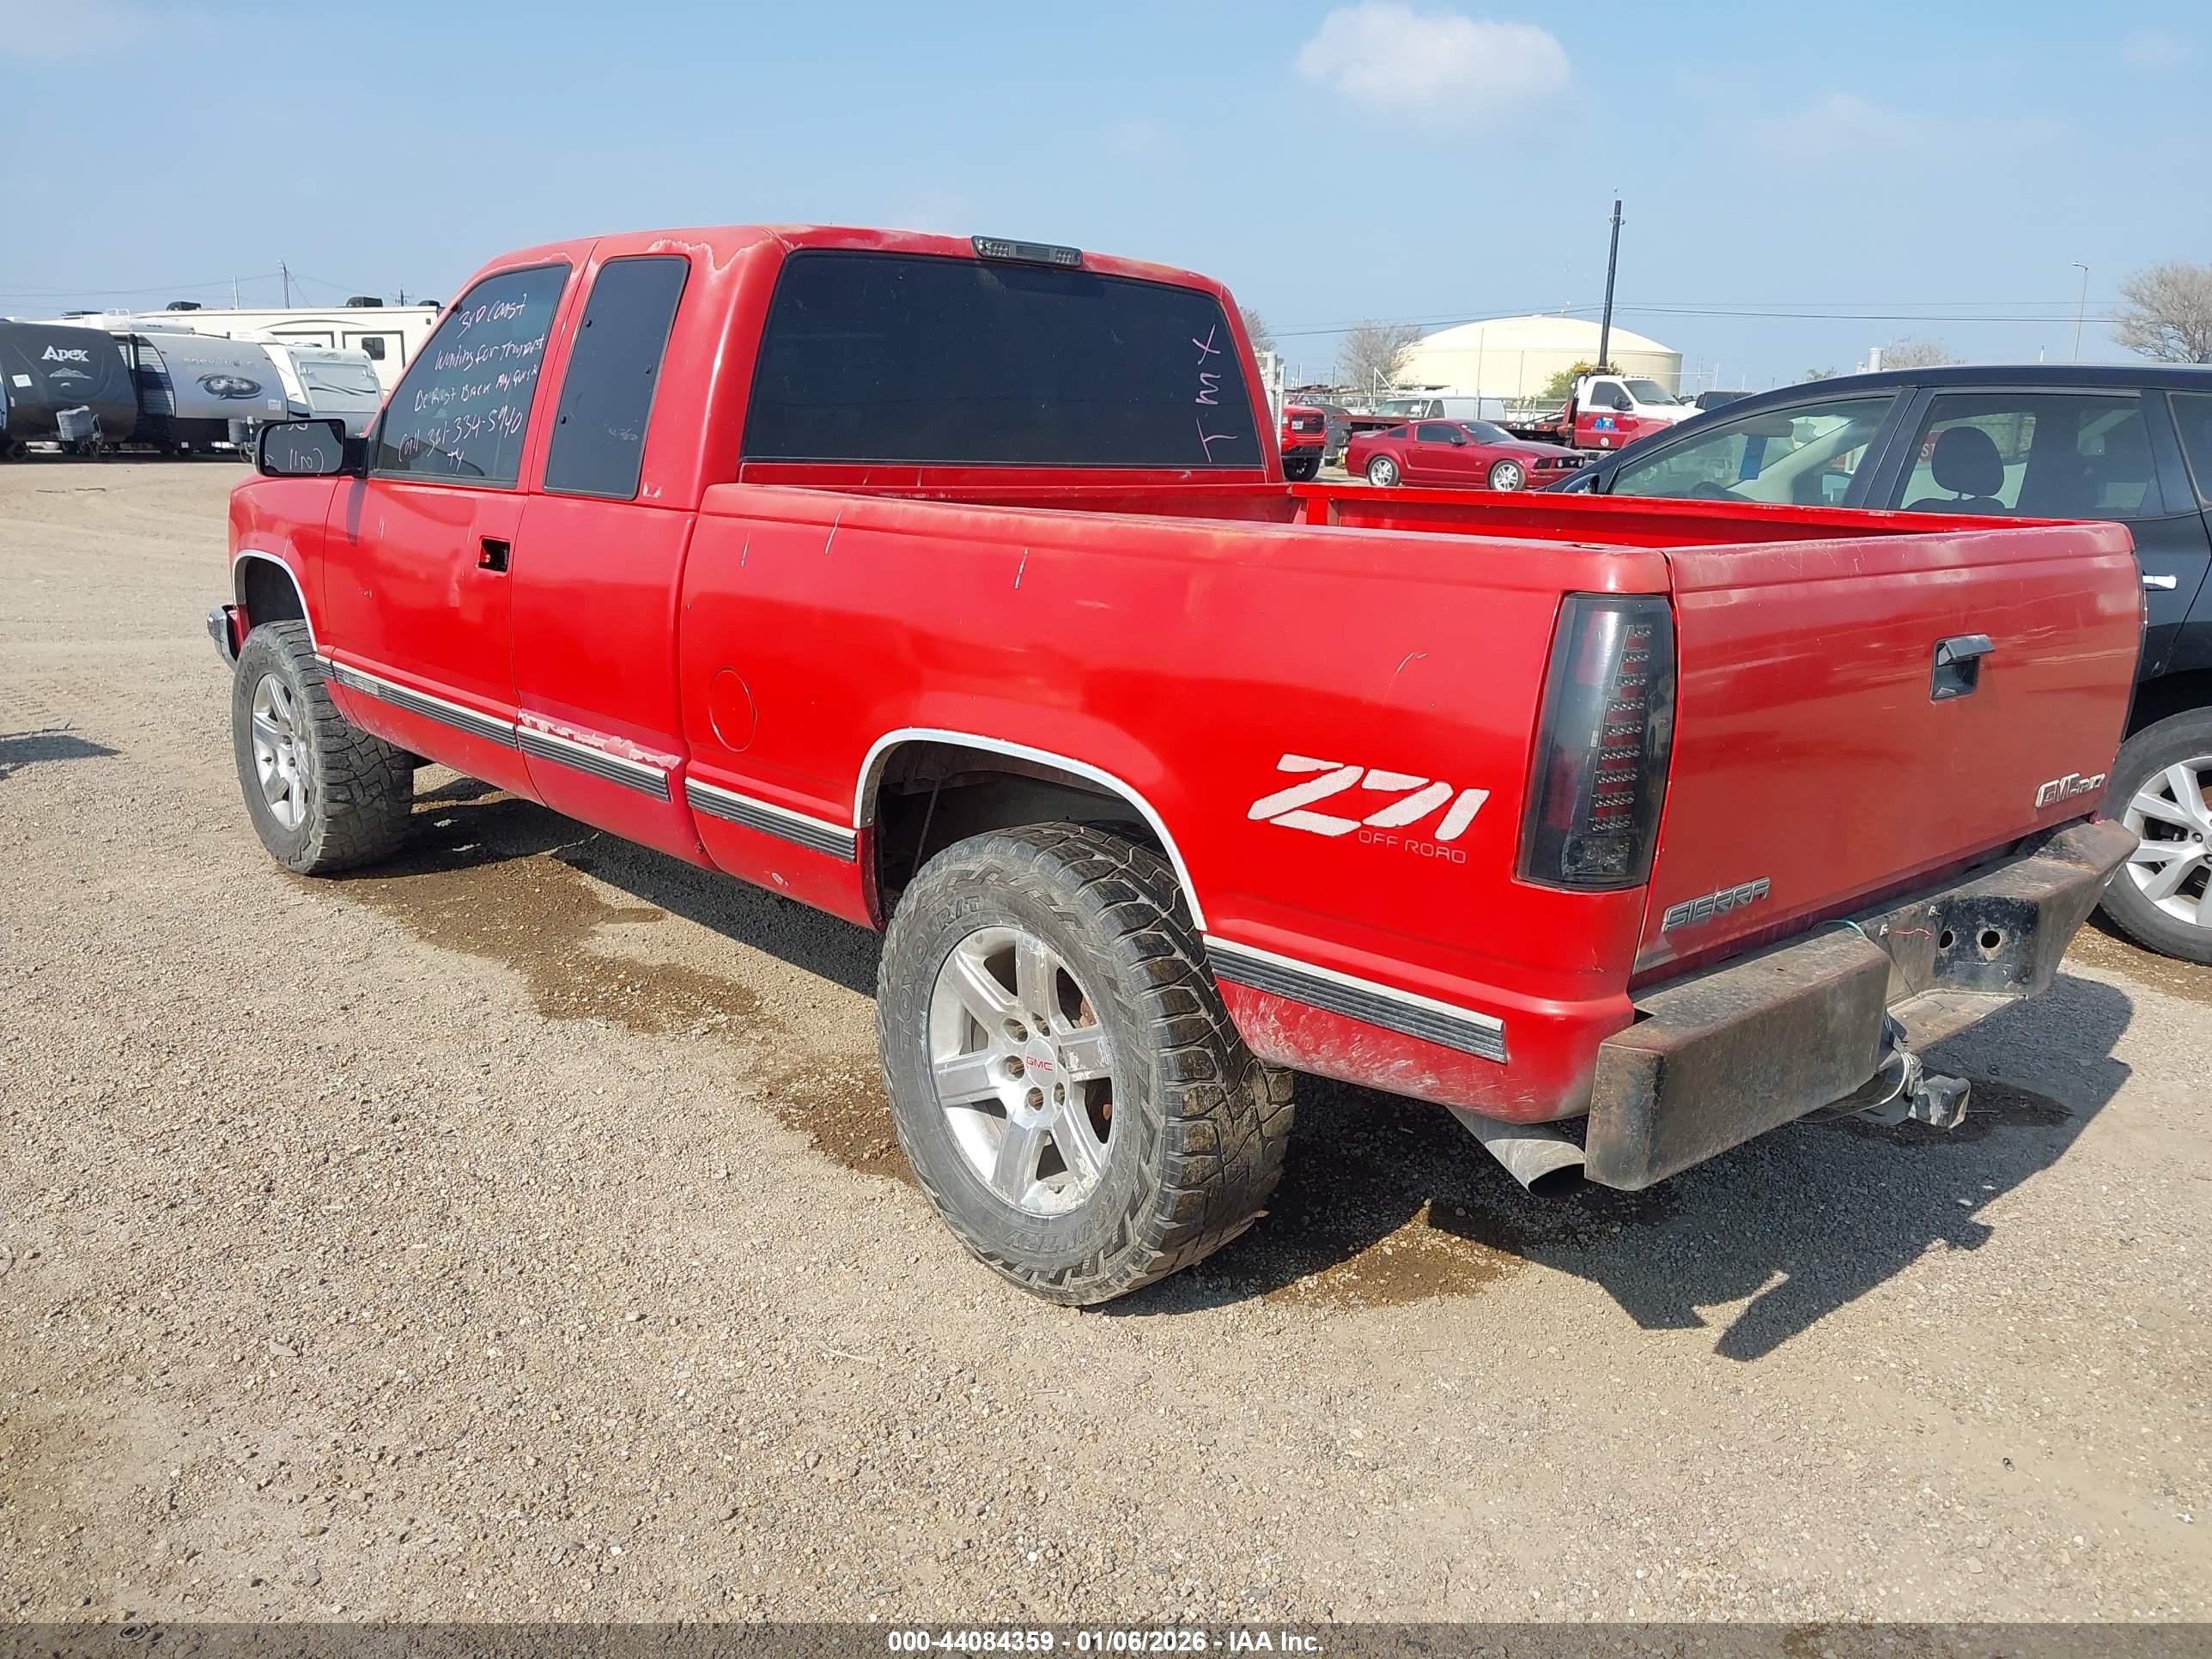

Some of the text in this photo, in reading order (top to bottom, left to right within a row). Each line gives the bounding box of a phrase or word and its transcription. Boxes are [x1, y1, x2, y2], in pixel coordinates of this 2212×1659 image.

[41, 345, 90, 362] Apex
[1247, 753, 1491, 842] Z71
[1358, 829, 1467, 865] OFF ROAD
[1661, 876, 1771, 933] SIERRA
[1026, 1056, 1054, 1072] GMC
